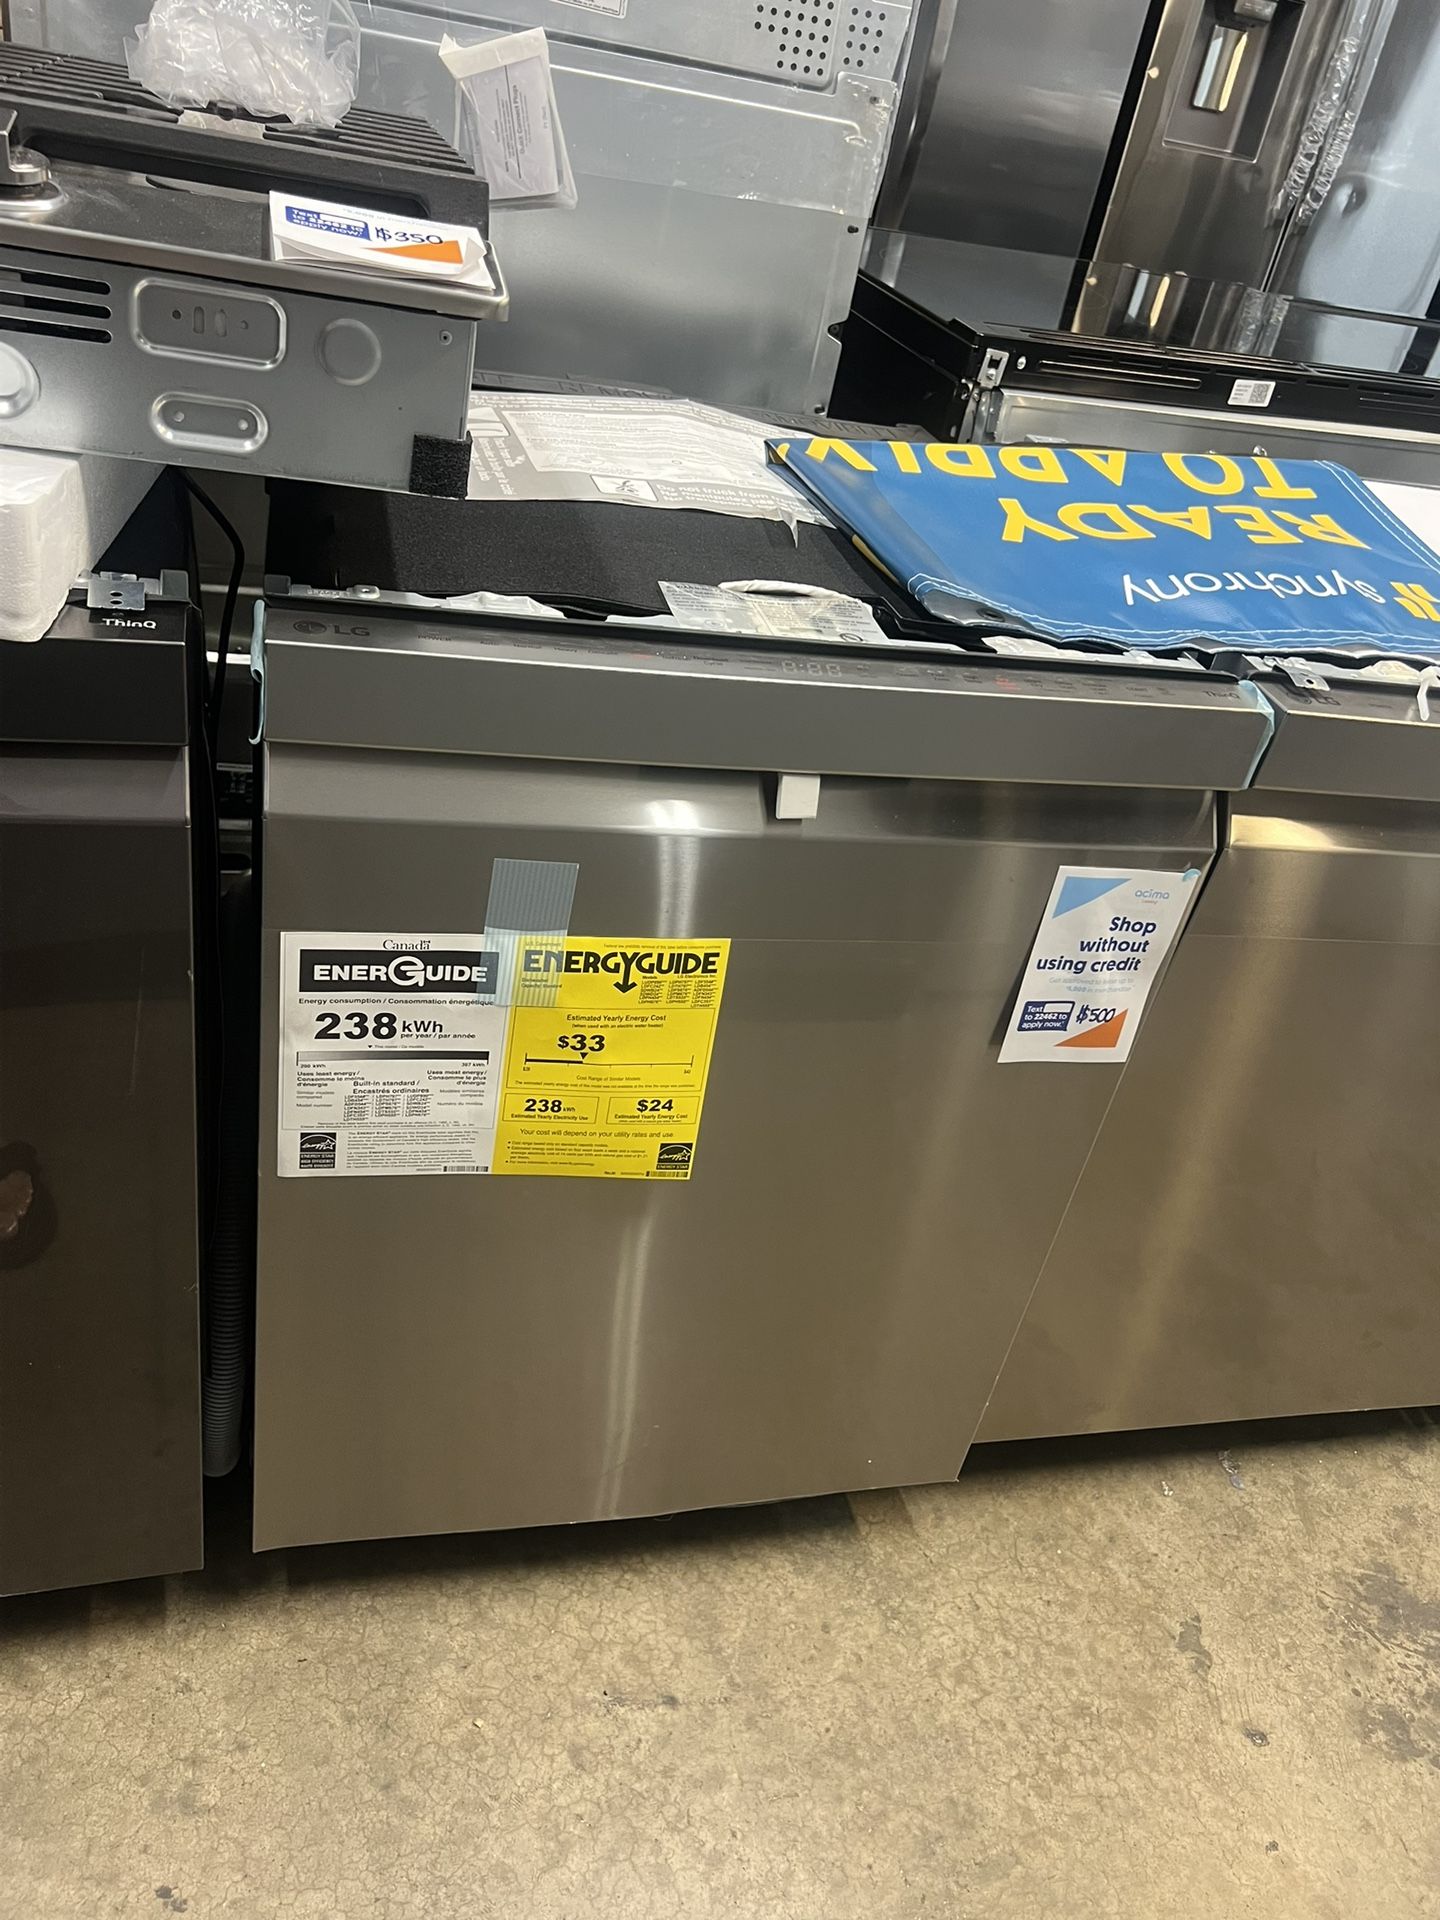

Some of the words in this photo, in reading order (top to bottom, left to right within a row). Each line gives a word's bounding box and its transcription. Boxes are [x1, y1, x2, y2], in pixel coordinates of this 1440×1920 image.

[998, 497, 1372, 551] READY
[1124, 568, 1383, 606] synchrony
[102, 618, 156, 629] ThinQ
[334, 624, 370, 636] LG
[1135, 888, 1170, 900] acima
[1109, 916, 1157, 936] Shop
[382, 939, 431, 950] Canada
[1080, 937, 1150, 953] without
[524, 950, 720, 974] ENERGYGUIDE
[1036, 956, 1087, 974] using
[1090, 957, 1141, 972] credit
[313, 956, 488, 987] ENERGUIDE
[1076, 1004, 1116, 1024] $500
[314, 1012, 397, 1040] 238
[402, 1020, 443, 1033] kWh
[1022, 1021, 1042, 1029] apply
[558, 1034, 606, 1052] $33
[524, 1098, 562, 1113] 238
[636, 1099, 674, 1113] $24
